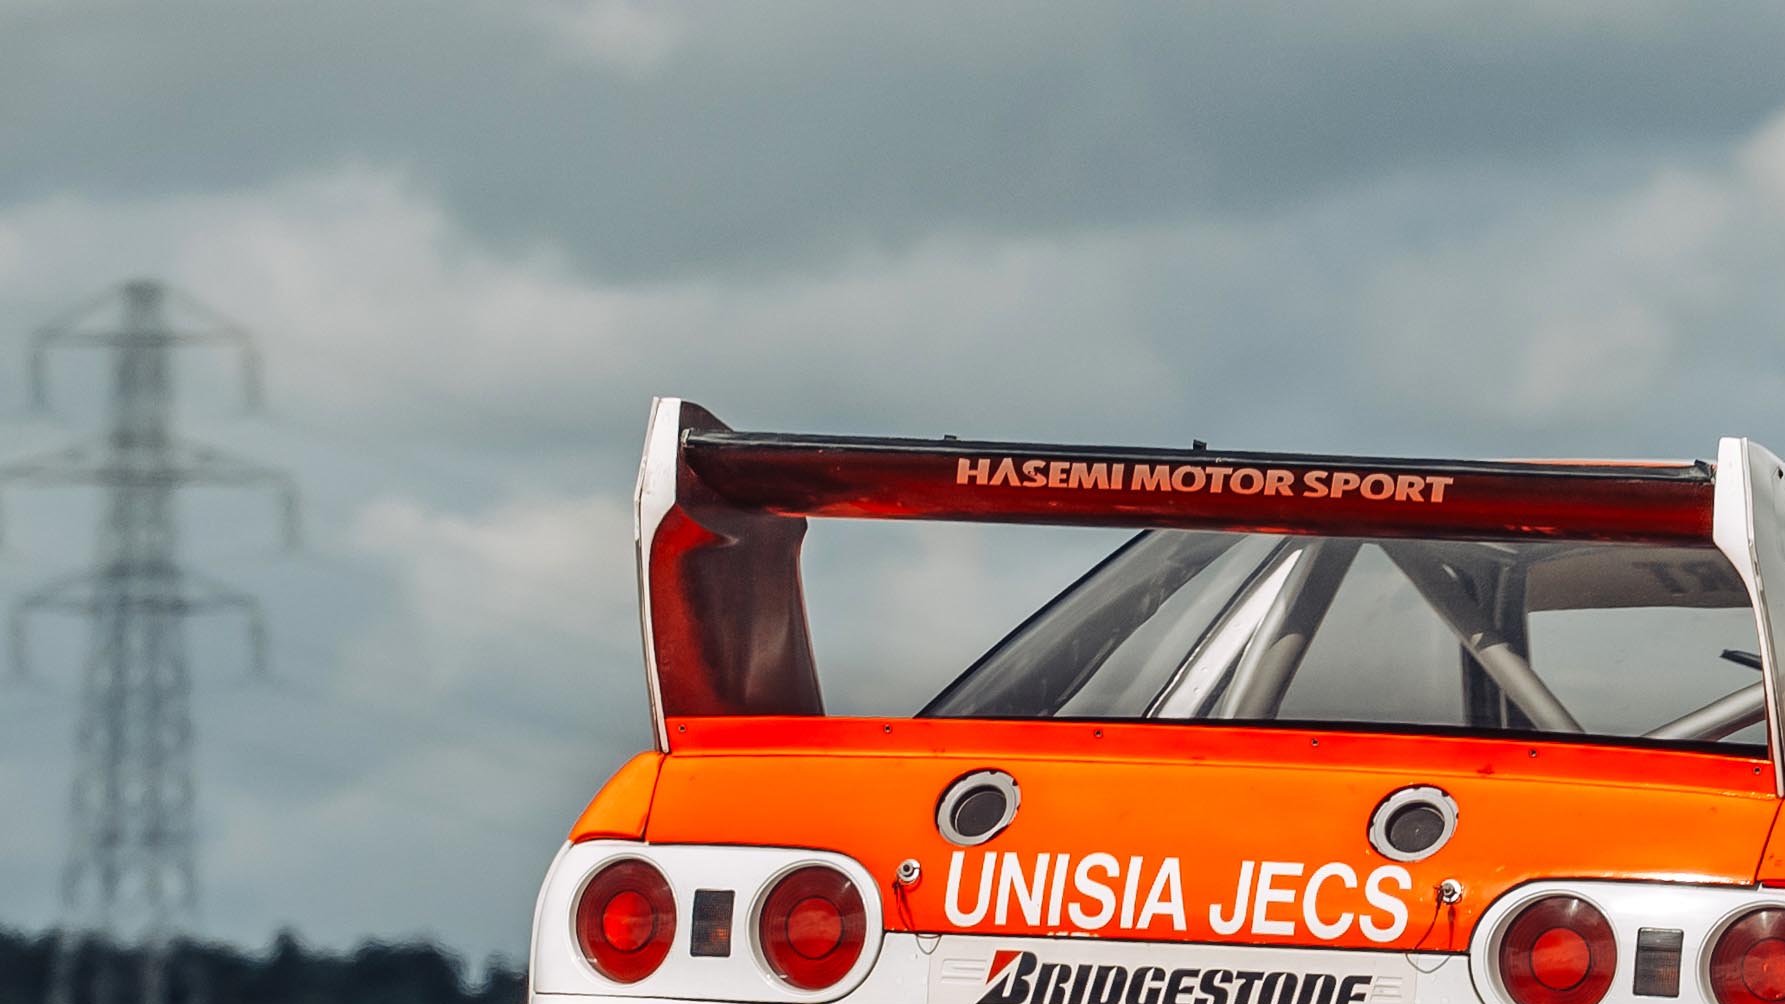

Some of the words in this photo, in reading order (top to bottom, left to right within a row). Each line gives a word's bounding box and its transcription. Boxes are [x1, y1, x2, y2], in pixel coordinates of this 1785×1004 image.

[956, 457, 1123, 491] HASEMI
[1130, 464, 1294, 497] MOTOR
[1302, 470, 1454, 503] SPORT
[943, 850, 1189, 930] UNISIA
[1208, 860, 1413, 944] JECS
